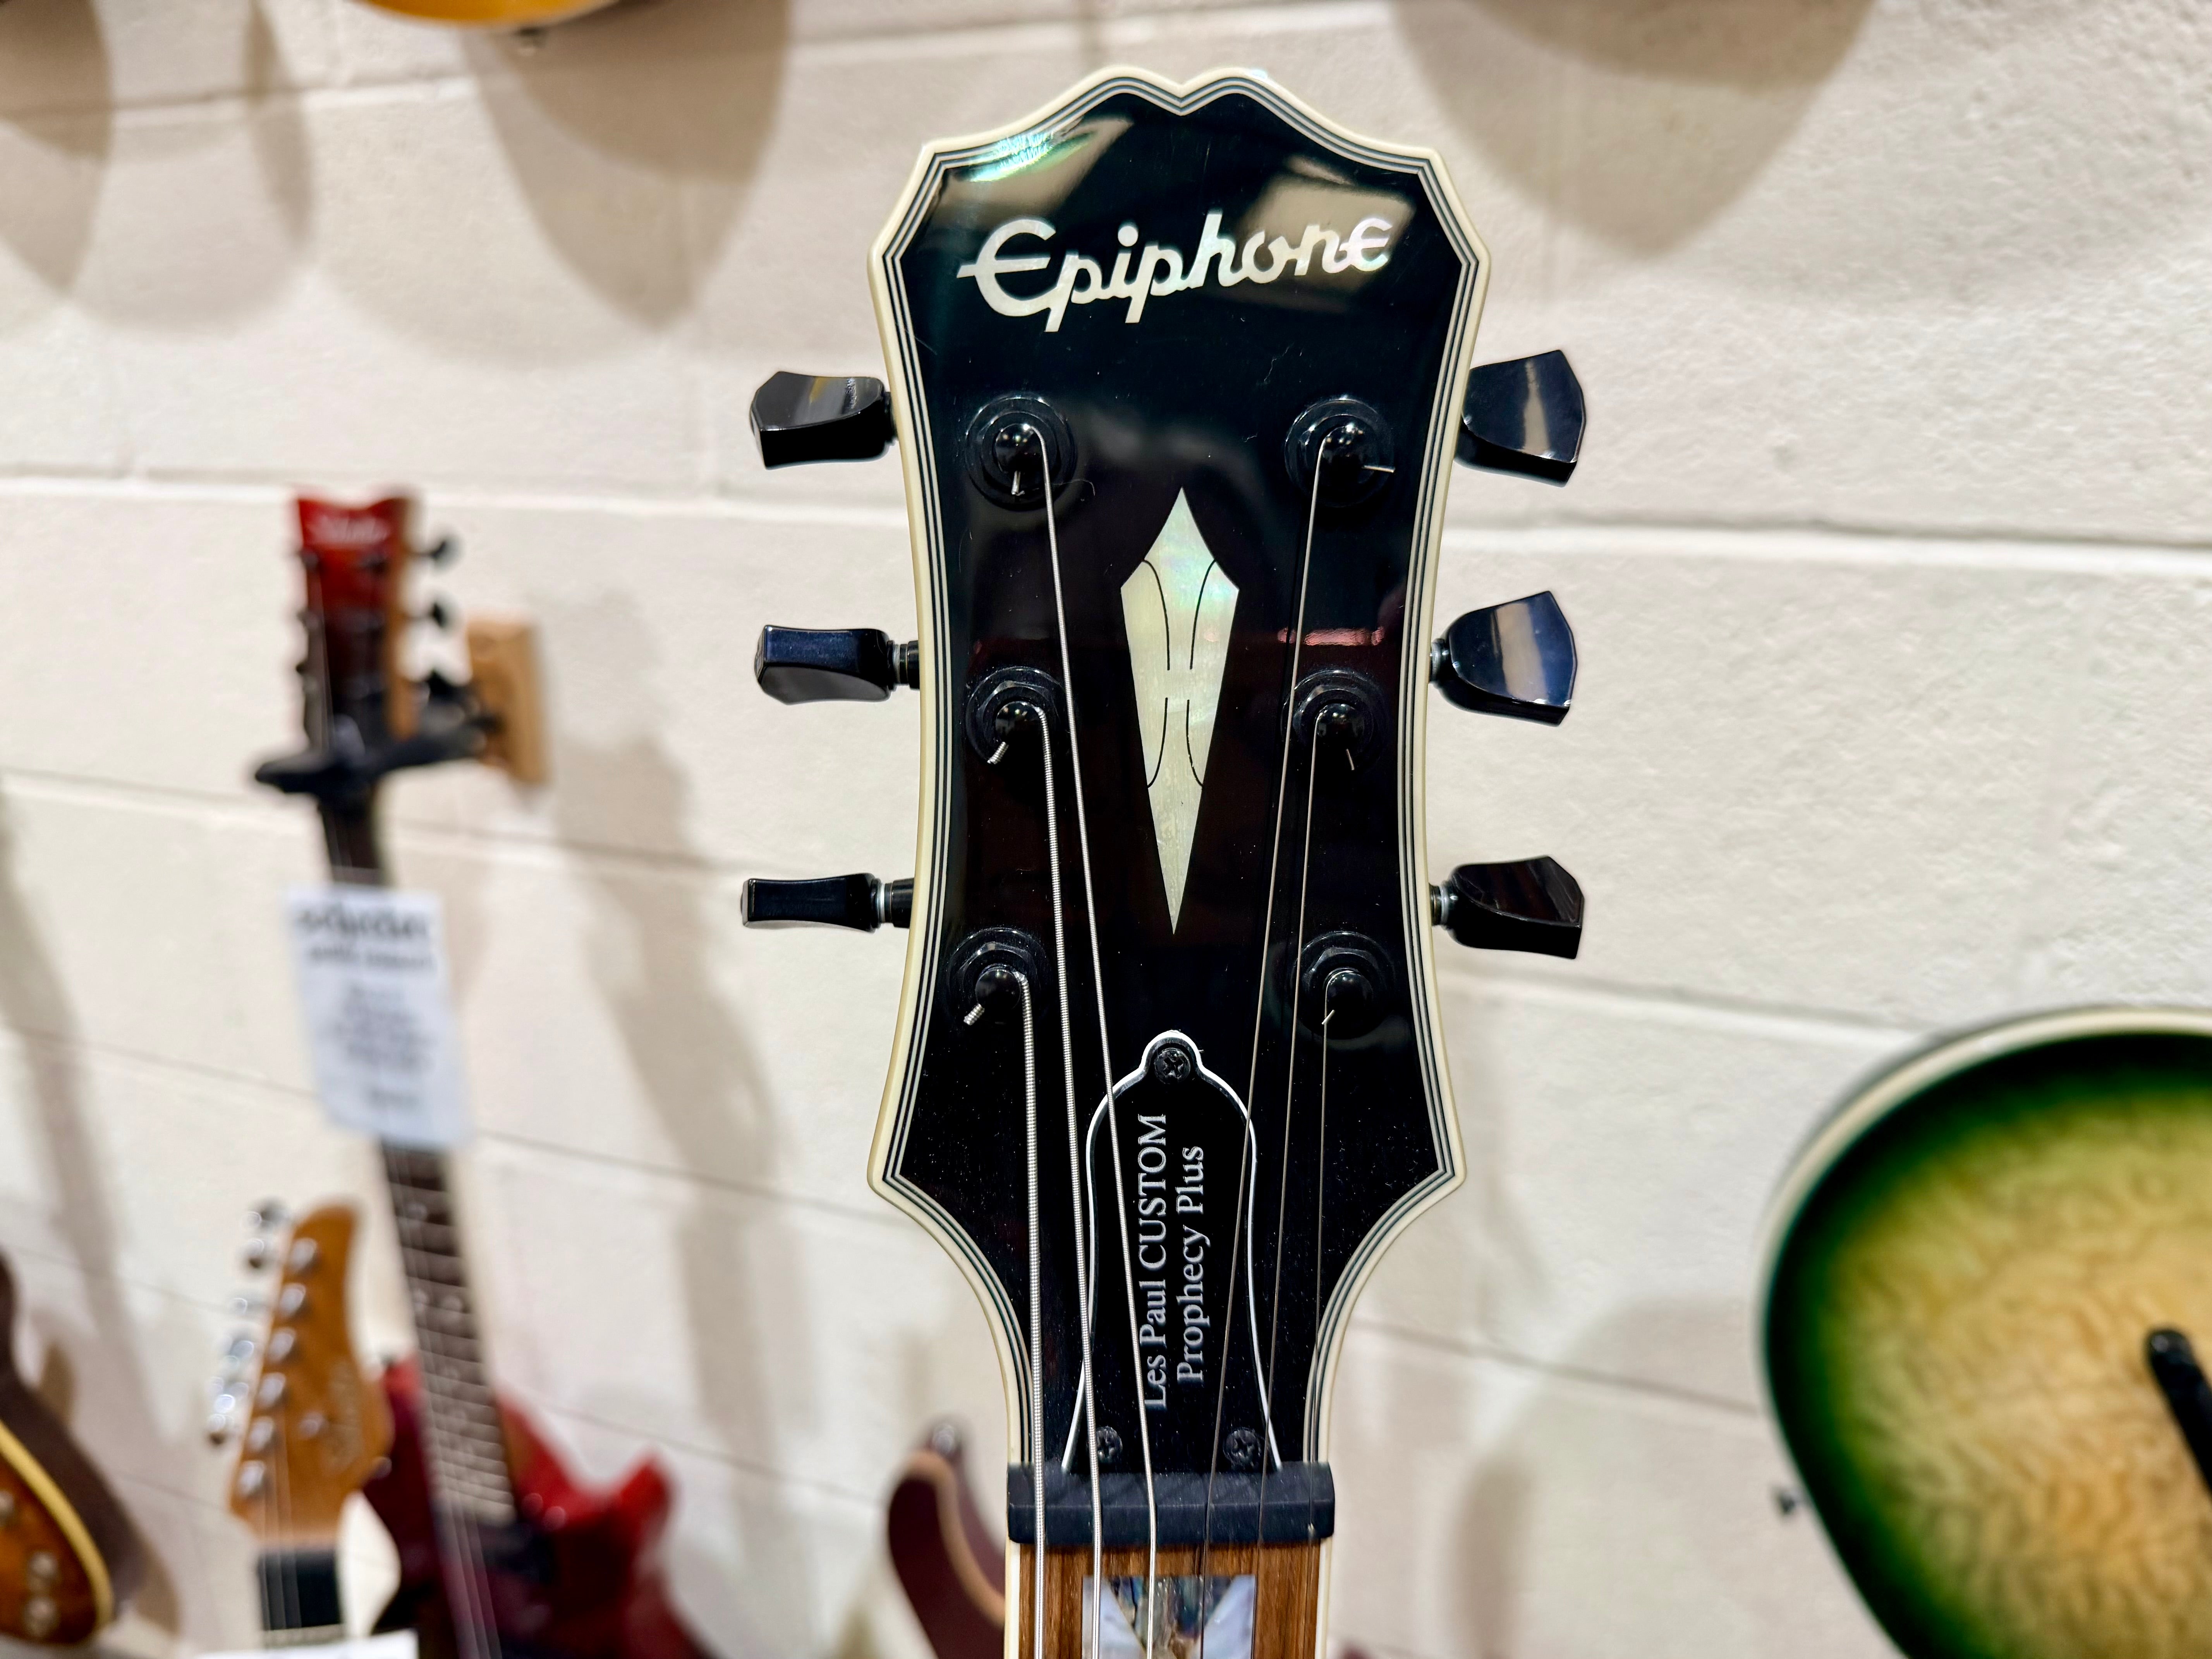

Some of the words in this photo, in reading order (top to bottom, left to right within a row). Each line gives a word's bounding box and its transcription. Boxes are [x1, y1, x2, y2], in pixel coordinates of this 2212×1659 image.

[957, 208, 1393, 332] Epiphone
[1138, 1113, 1166, 1270] CUSTOM
[1175, 1146, 1204, 1214] Plus
[1139, 1279, 1166, 1346] Paul
[1176, 1224, 1211, 1382] Prophecy
[1144, 1355, 1166, 1408] Les
